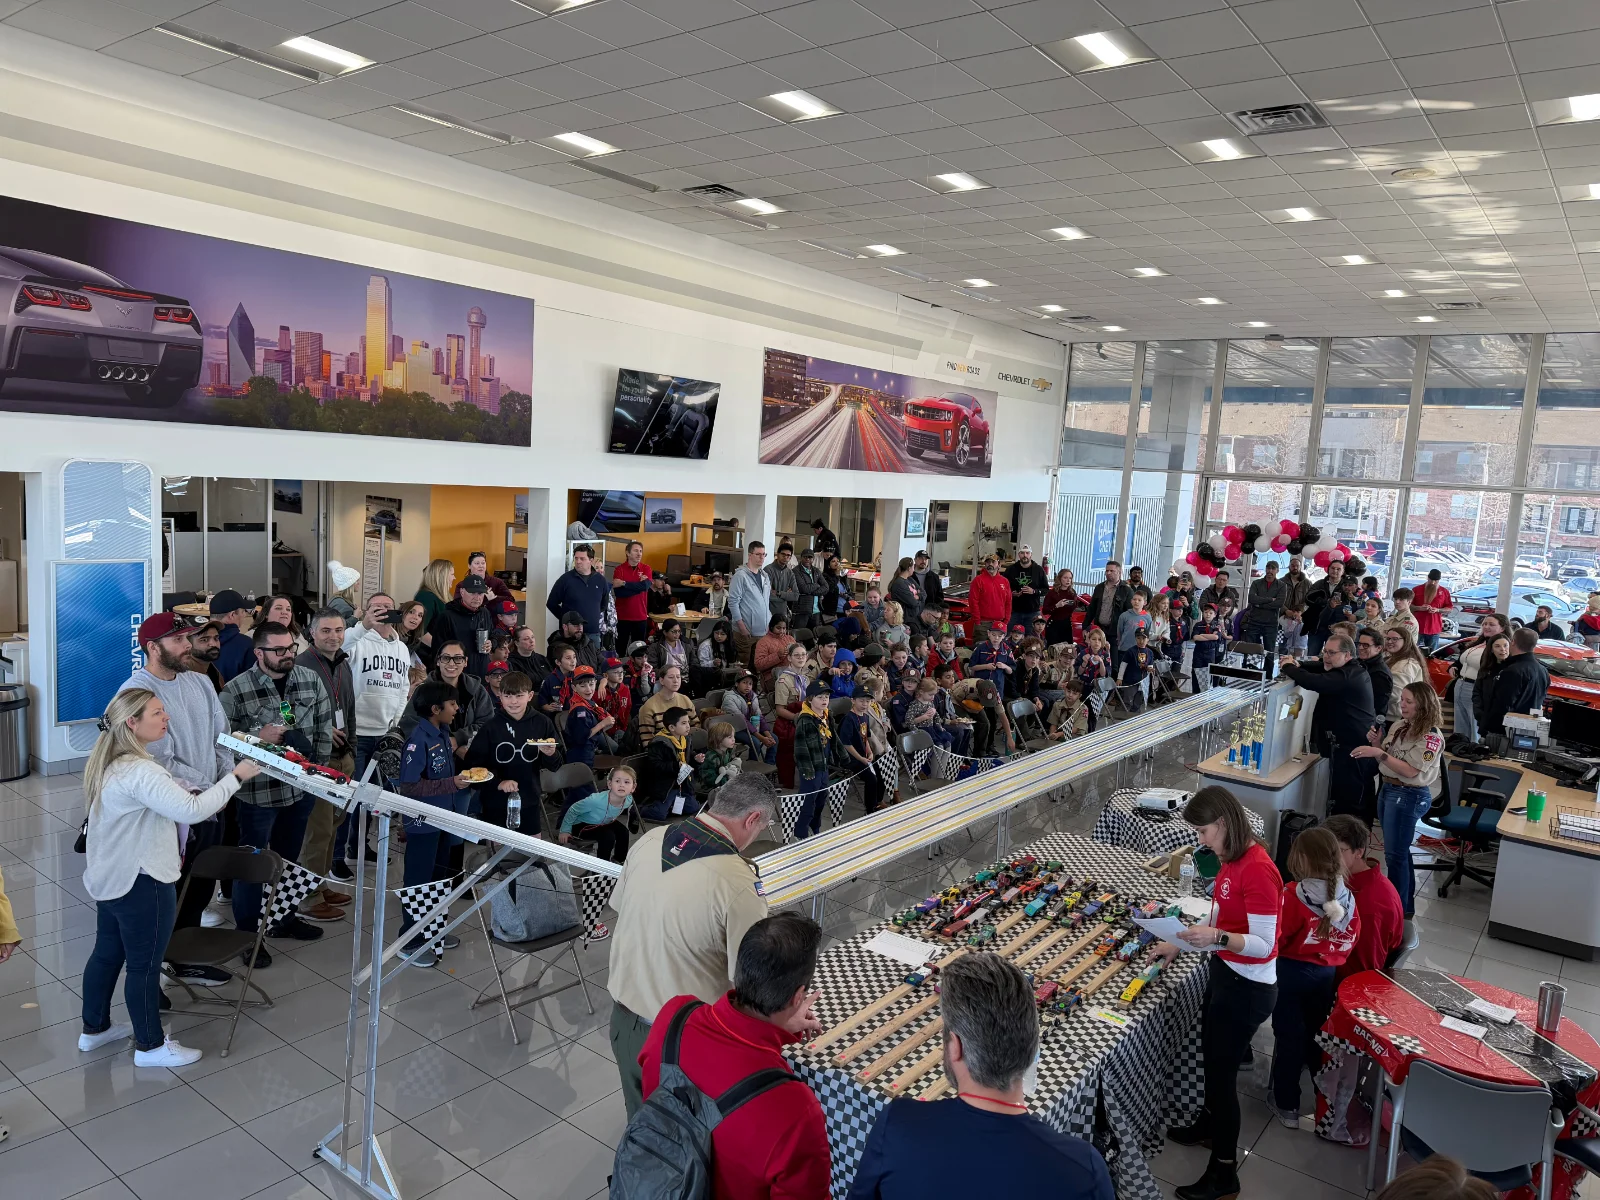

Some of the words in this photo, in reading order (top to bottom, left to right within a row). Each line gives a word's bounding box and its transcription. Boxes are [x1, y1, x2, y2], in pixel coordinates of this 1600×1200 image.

[997, 372, 1031, 386] CHEVROLET
[619, 394, 653, 405] personality
[131, 613, 142, 676] CHEVR
[362, 655, 409, 677] LONDON
[366, 678, 401, 689] ENGLAND
